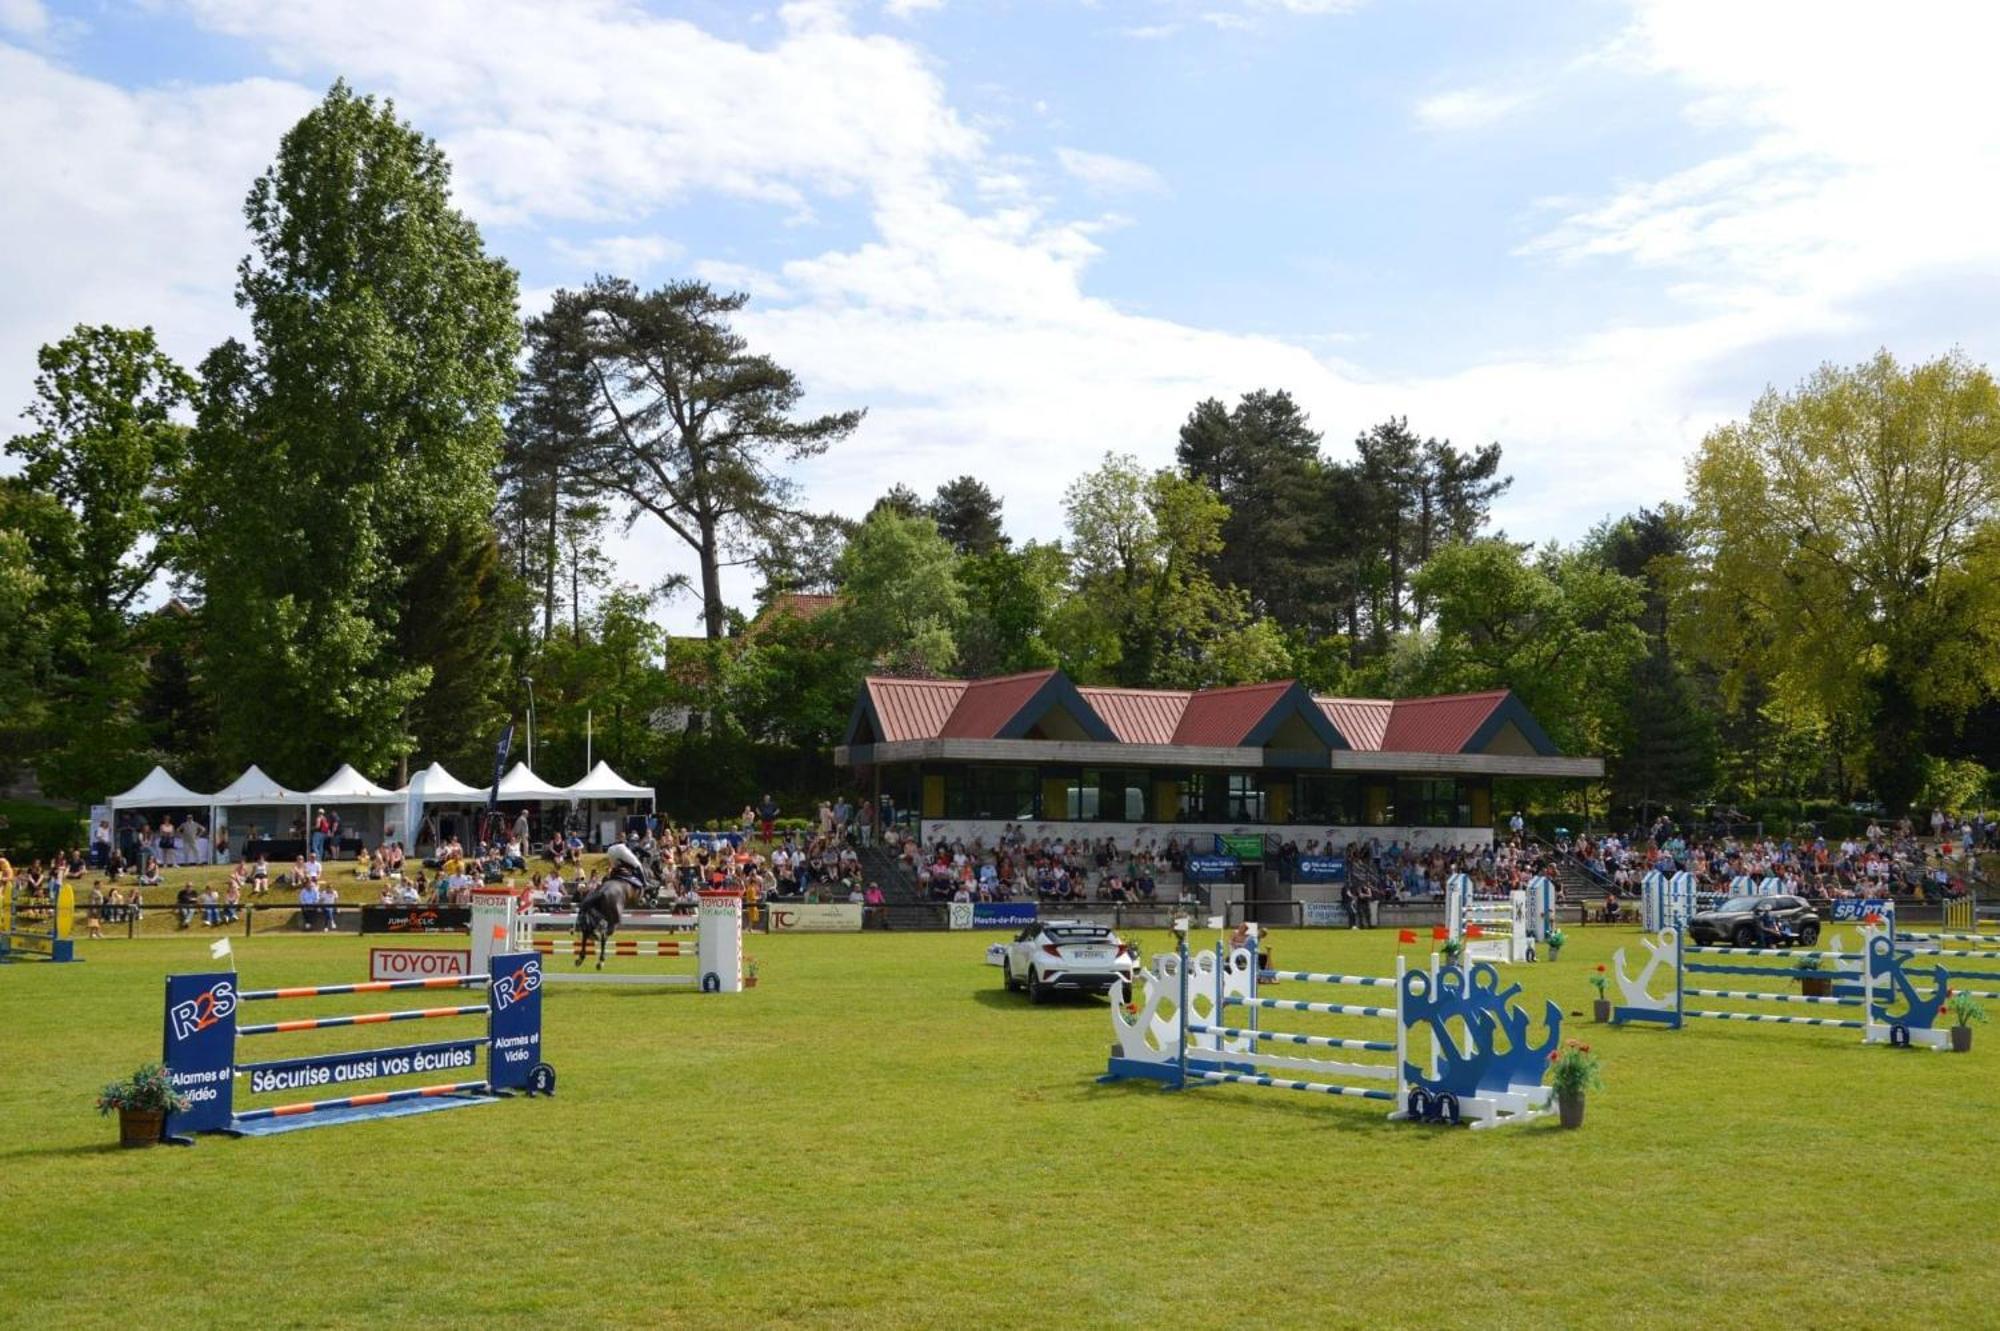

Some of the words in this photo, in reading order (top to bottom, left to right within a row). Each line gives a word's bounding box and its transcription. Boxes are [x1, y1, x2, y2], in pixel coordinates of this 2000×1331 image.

[702, 898, 736, 908] TOYOTA
[379, 954, 461, 975] TOYOTA
[493, 960, 542, 1010] R2S
[170, 981, 237, 1041] R2S
[495, 1036, 528, 1049] Alarmes
[530, 1033, 539, 1045] et
[504, 1050, 529, 1063] Vidéo
[171, 1071, 217, 1086] Alarmes
[218, 1066, 230, 1081] et
[252, 1065, 330, 1092] Sécurise
[335, 1056, 377, 1081] aussi
[381, 1055, 410, 1076] vos
[413, 1047, 473, 1071] écuries
[536, 1075, 547, 1089] 3
